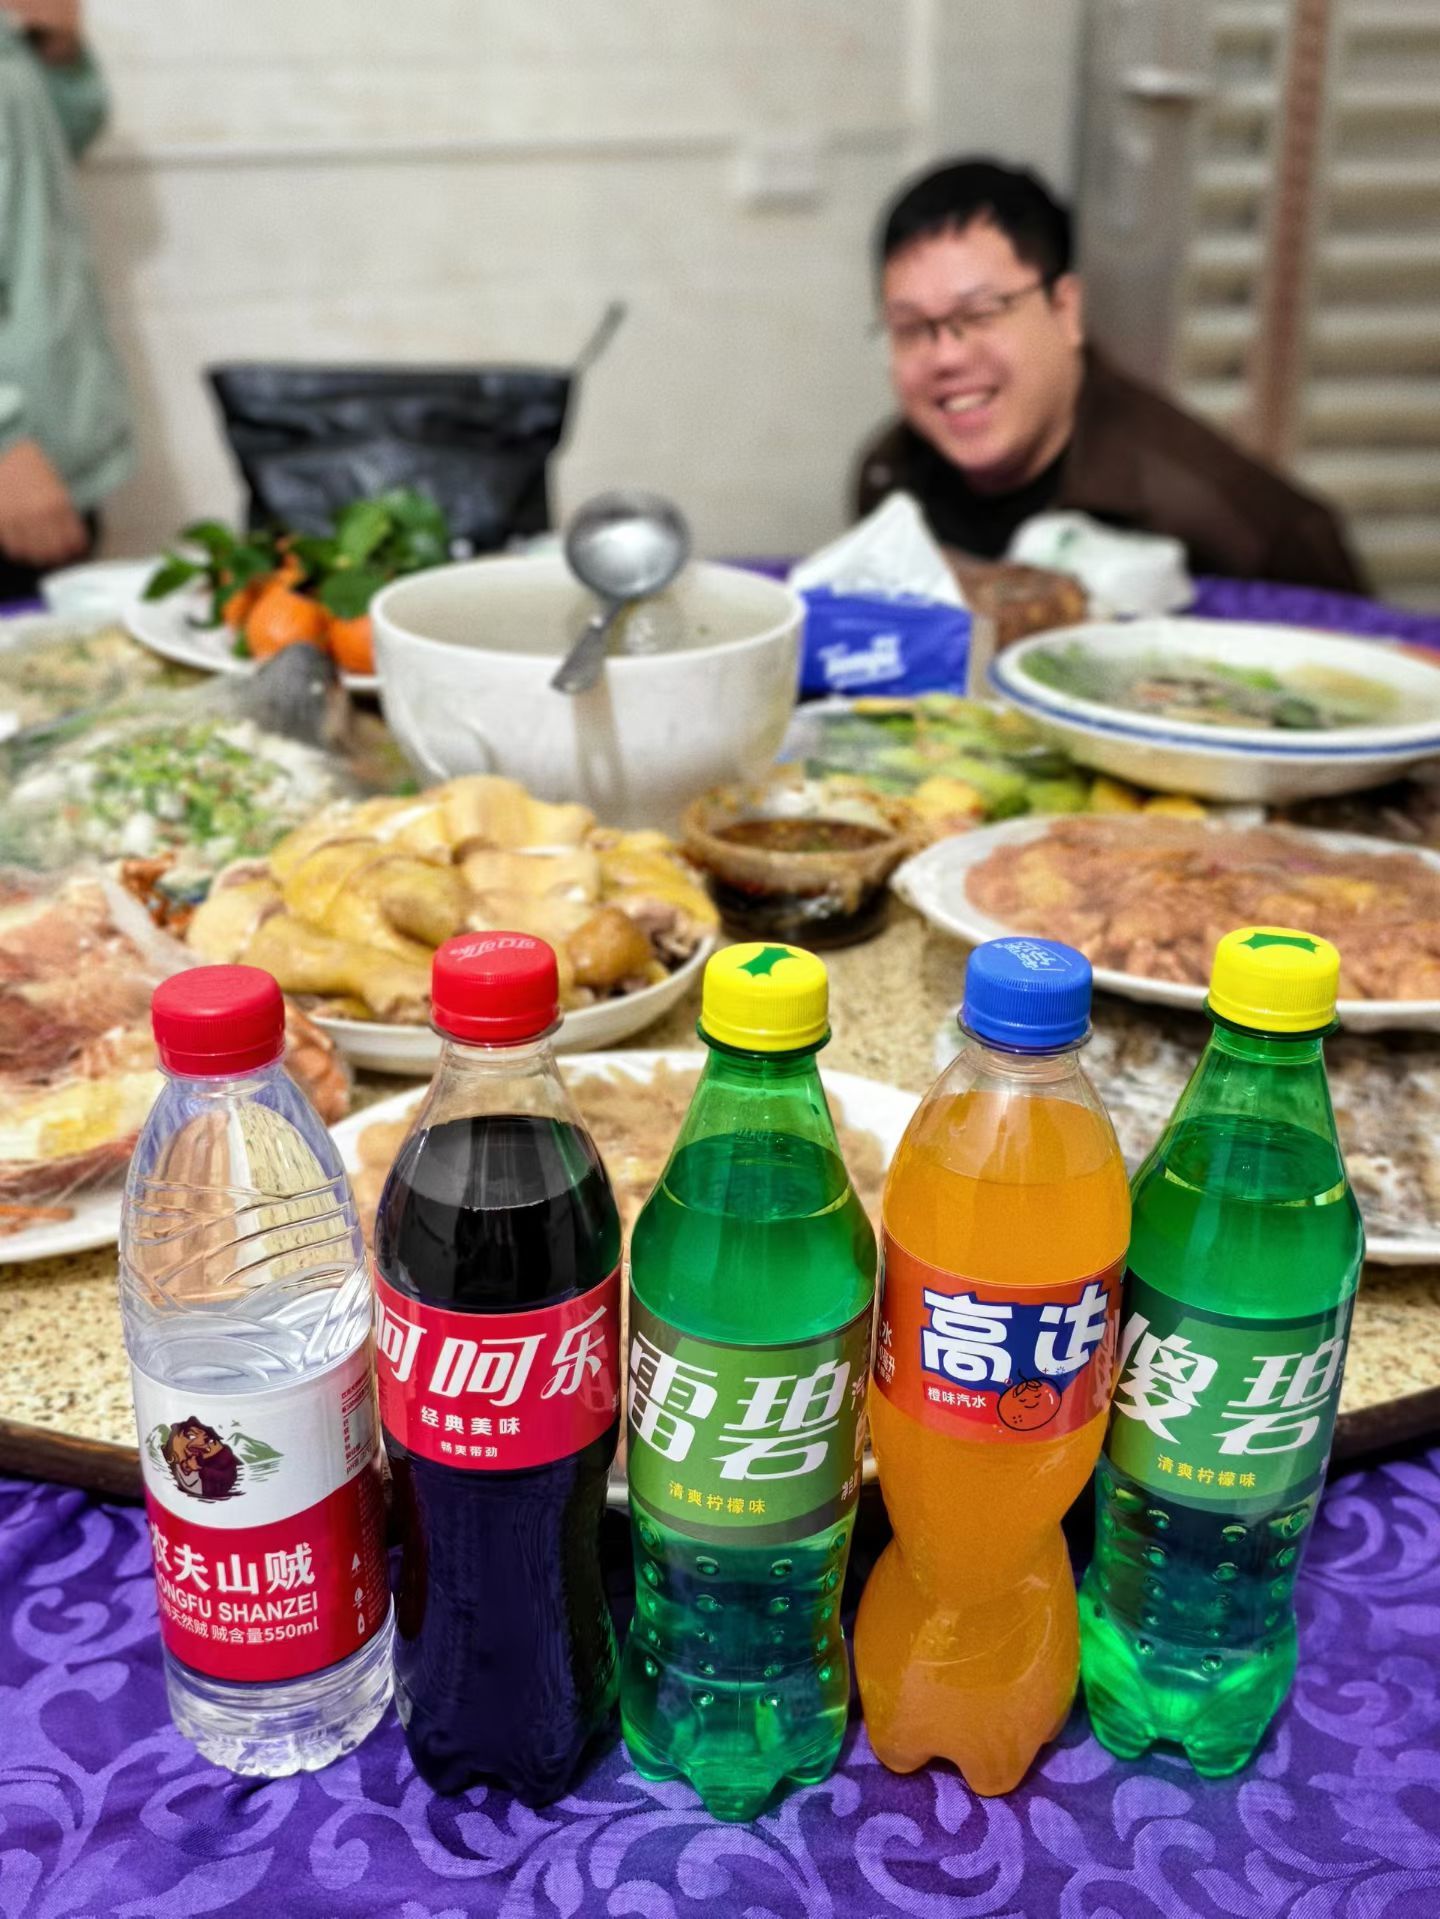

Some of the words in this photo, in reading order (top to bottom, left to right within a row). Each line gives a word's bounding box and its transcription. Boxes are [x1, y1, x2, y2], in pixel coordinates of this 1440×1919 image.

[922, 1283, 1109, 1385] 高达
[927, 1386, 988, 1409] 橙味汽水
[1113, 1311, 1344, 1456] 傻碧
[420, 1405, 521, 1437] 经典美味
[627, 1331, 851, 1481] 雷碧
[440, 1441, 498, 1459] 畅爽带劲
[1156, 1454, 1257, 1488] 清爽柠檬味
[668, 1481, 767, 1515] 清爽柠檬味
[150, 1521, 316, 1595] 农夫山贼
[218, 1591, 319, 1623] SHANZEI
[211, 1616, 320, 1645] 贼含量550ml
